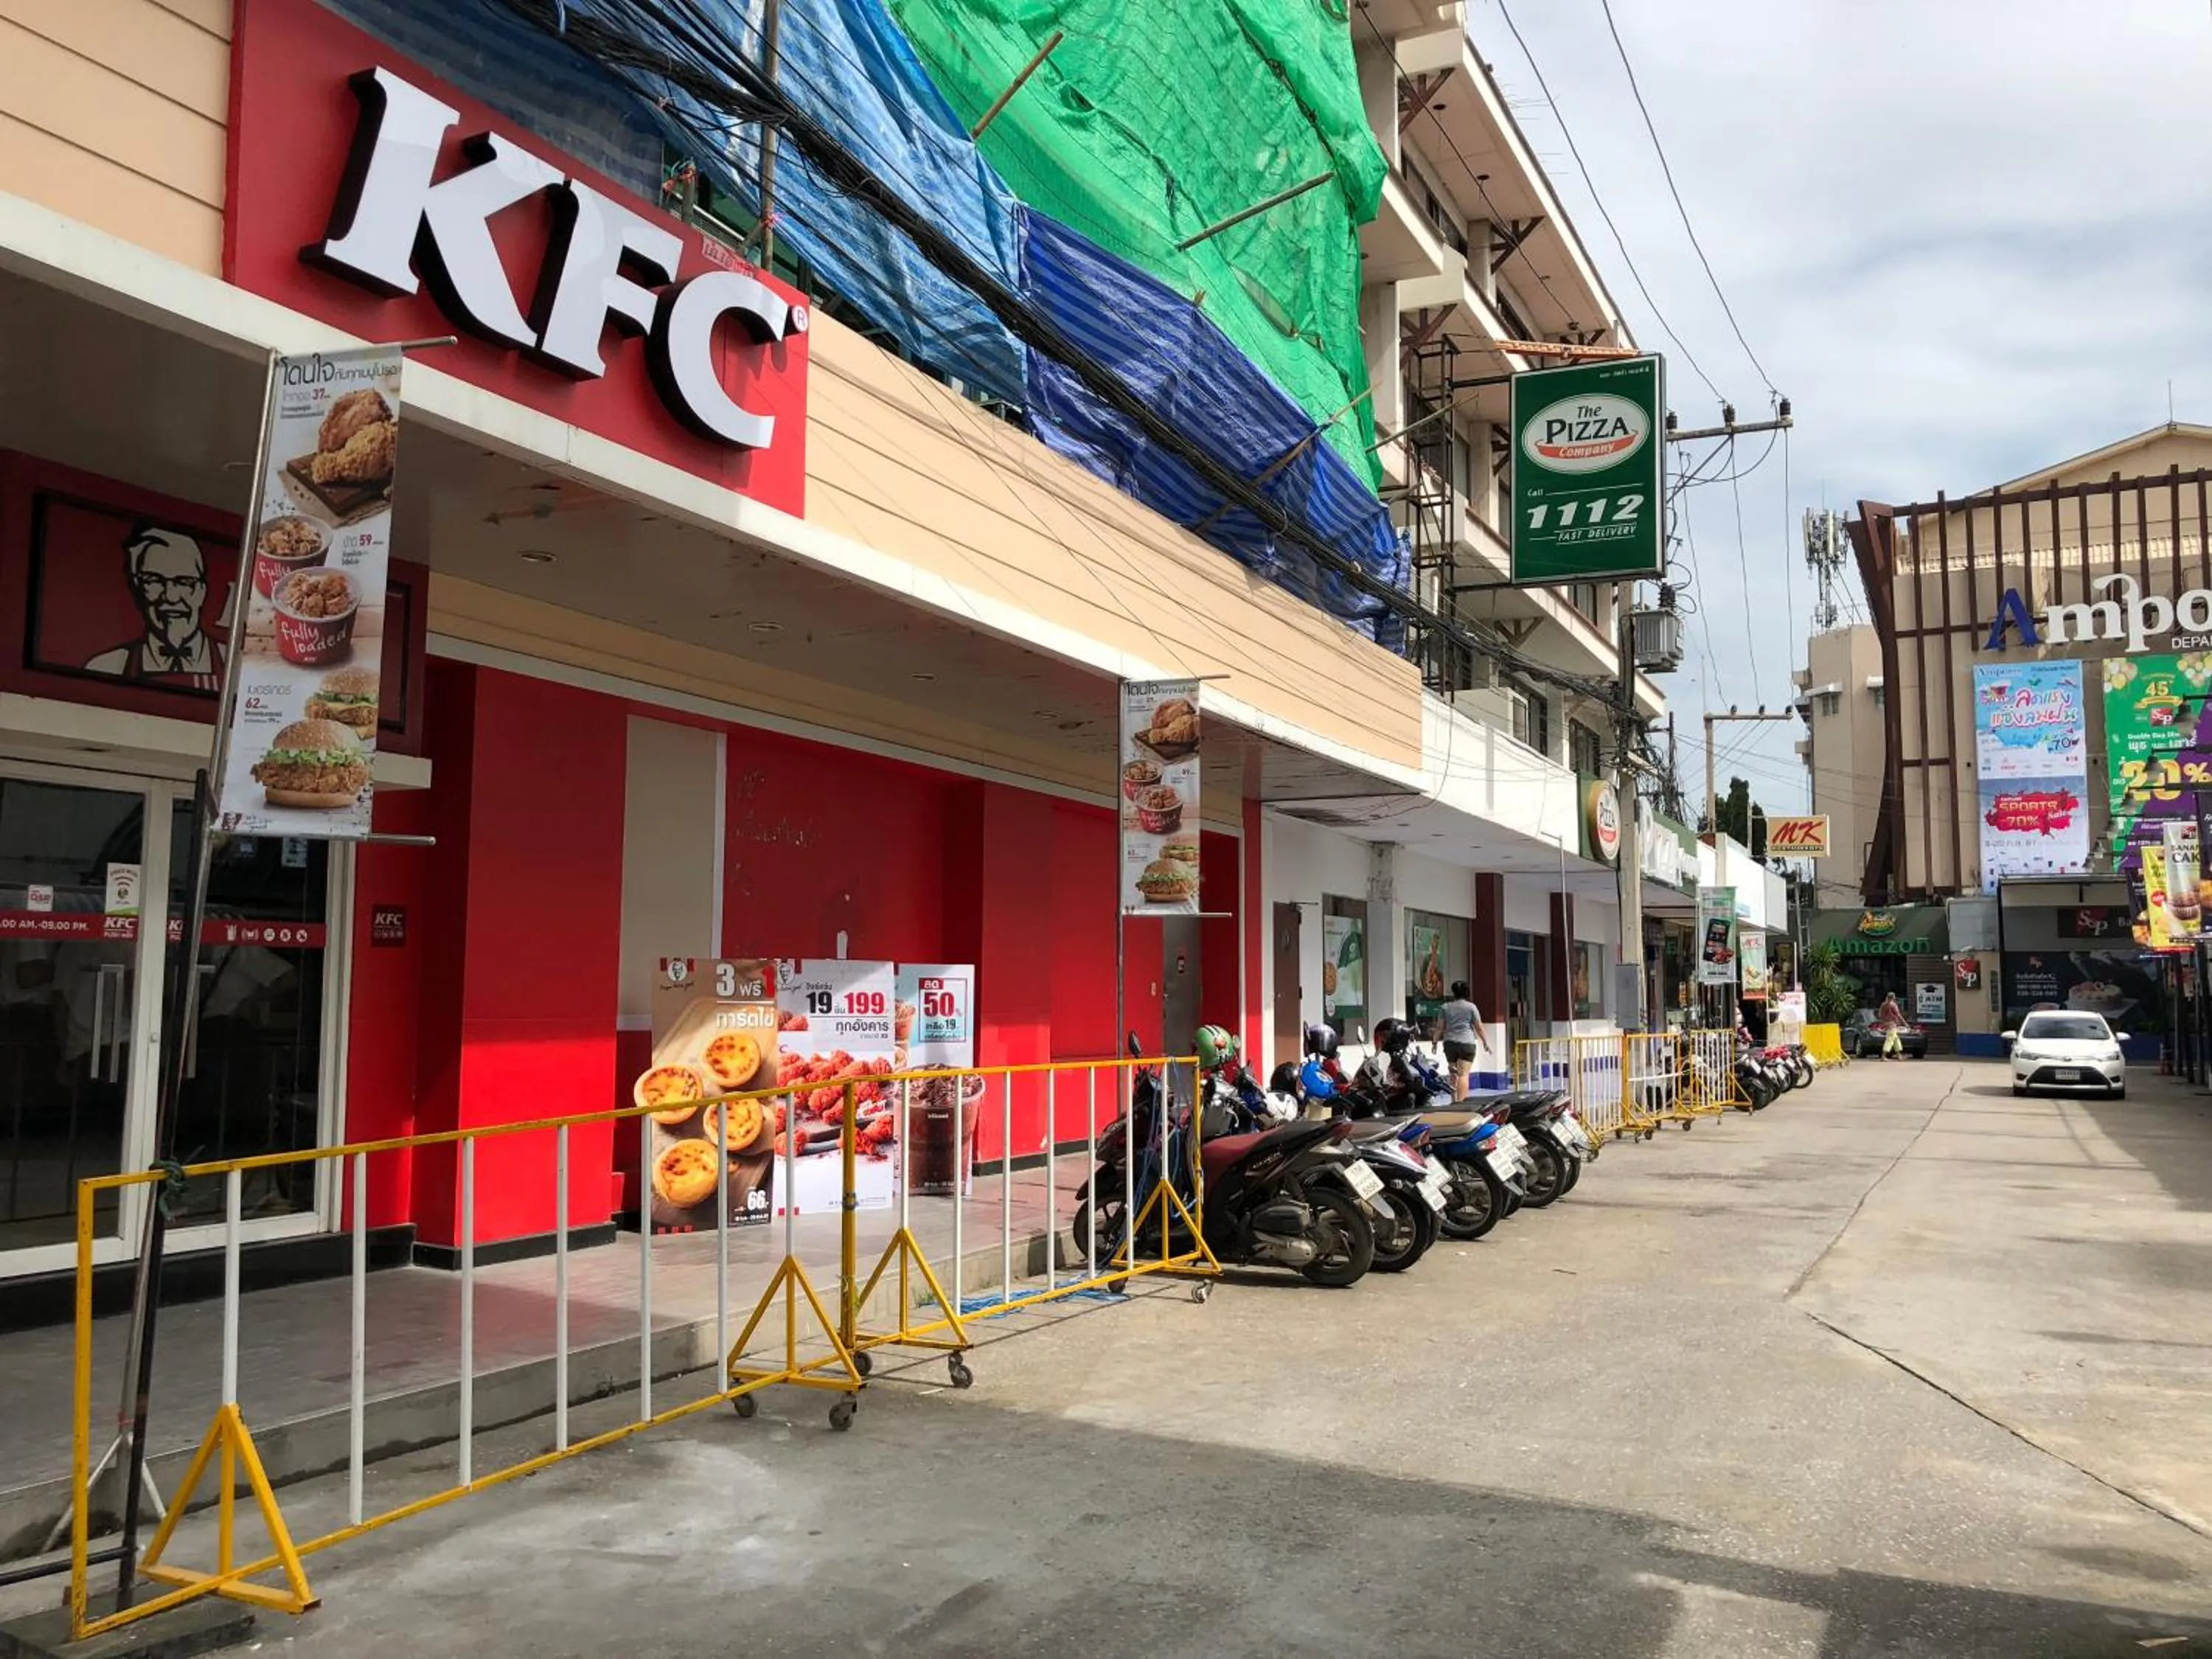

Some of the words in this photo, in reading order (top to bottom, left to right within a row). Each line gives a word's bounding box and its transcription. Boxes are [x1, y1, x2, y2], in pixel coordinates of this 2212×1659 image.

[313, 66, 788, 449] KFC
[1578, 406, 1601, 418] The
[1559, 442, 1615, 459] Company
[1528, 489, 1543, 497] Call
[1527, 495, 1644, 529] 1112
[1557, 531, 1582, 542] FAST
[1587, 526, 1636, 538] DELIVERY
[281, 621, 319, 642] fully
[293, 623, 347, 653] loaded
[246, 698, 260, 709] 62
[1999, 800, 2058, 813] SPORTS
[1772, 820, 1824, 844] MK
[104, 917, 135, 928] KFC
[375, 912, 403, 925] KFC
[1829, 935, 1930, 953] Amazon
[716, 964, 735, 996] 3
[762, 965, 775, 998] 1
[924, 980, 939, 989] ลด
[805, 991, 832, 1015] 19
[923, 992, 955, 1017] 50
[835, 1018, 889, 1035] ทุกอังคาร
